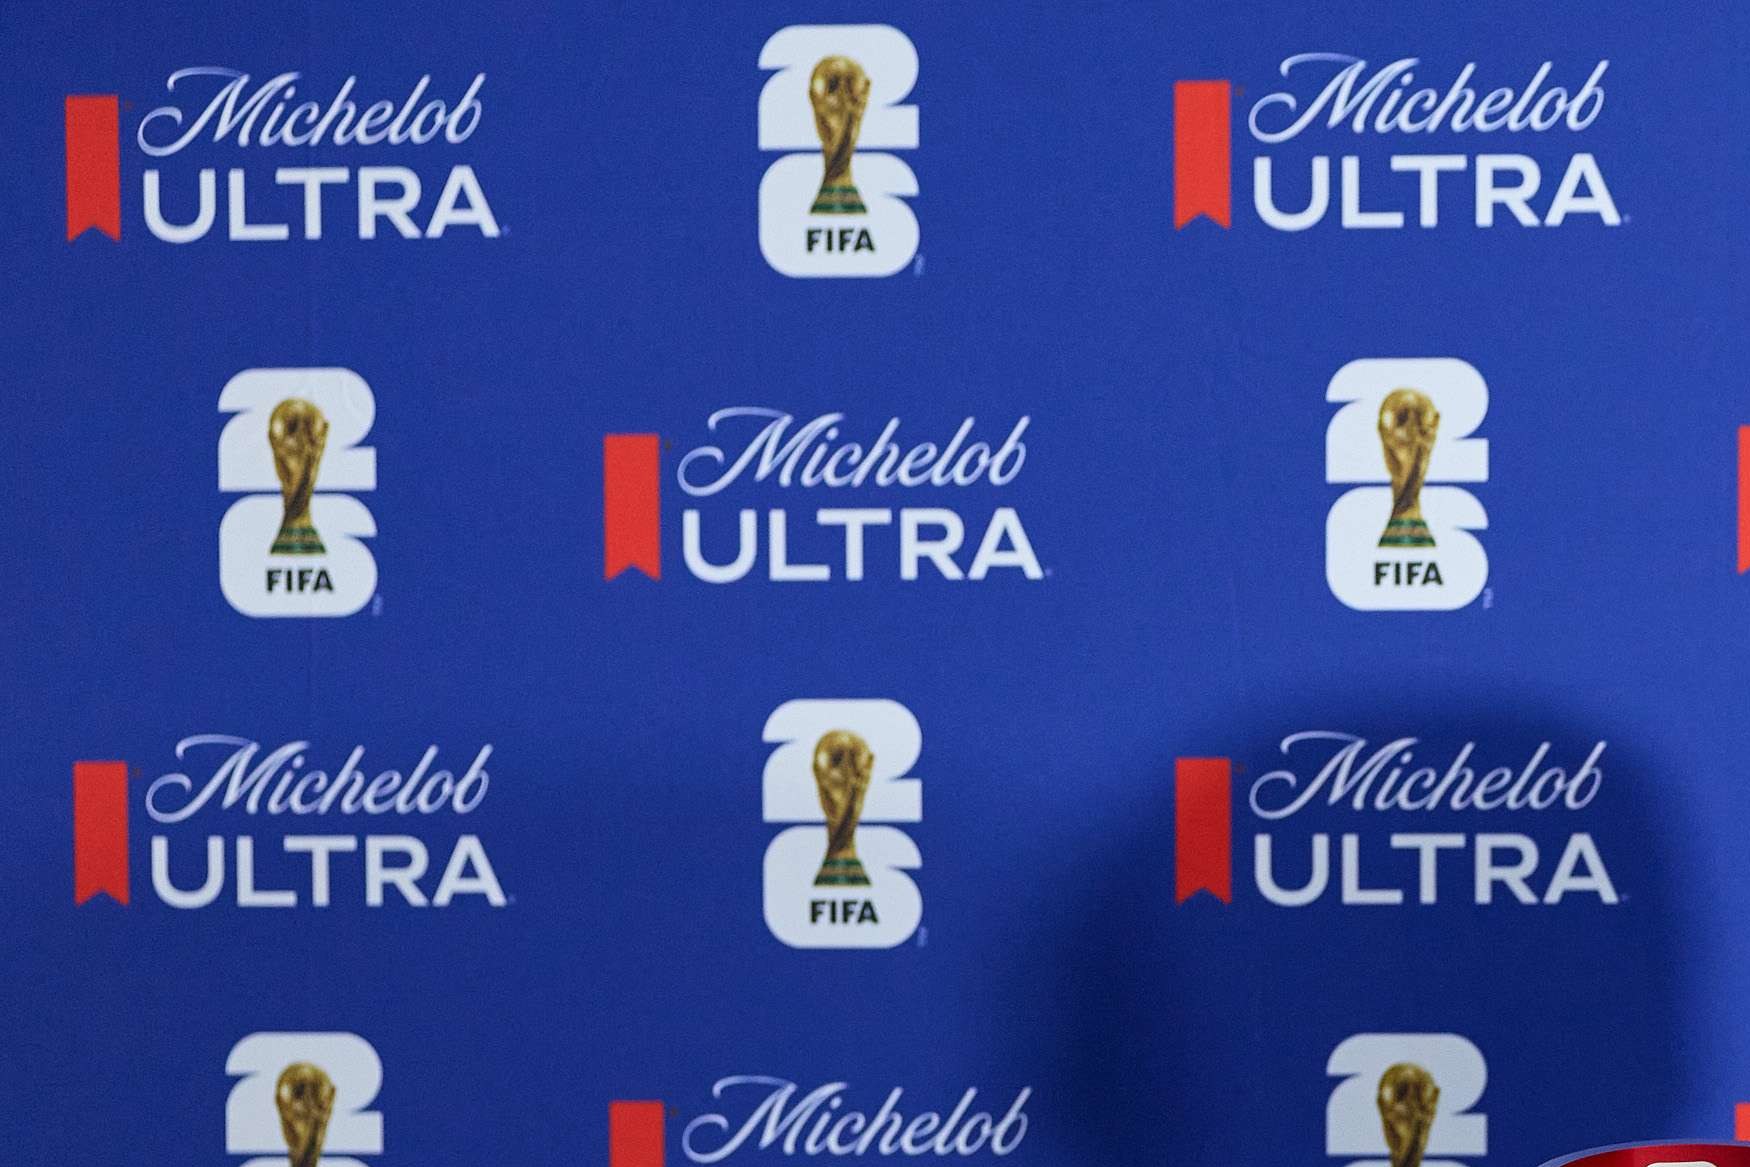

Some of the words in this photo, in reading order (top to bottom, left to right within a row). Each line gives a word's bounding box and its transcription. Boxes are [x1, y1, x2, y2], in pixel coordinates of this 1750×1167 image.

[138, 68, 485, 156] Michelob
[1249, 53, 1608, 143] Michelob
[143, 165, 500, 243] ULTRA
[1254, 153, 1621, 231] ULTRA
[807, 229, 875, 252] FIFA
[678, 407, 1030, 496] Michelob
[267, 569, 333, 592] FIFA
[683, 508, 1043, 583] ULTRA
[1375, 562, 1443, 585] FIFA
[146, 734, 493, 823] Michelob
[1249, 731, 1607, 819] Michelob
[151, 835, 507, 908] ULTRA
[1255, 833, 1618, 906] ULTRA
[811, 900, 878, 924] FIFA
[683, 1076, 1030, 1163] Michelob
